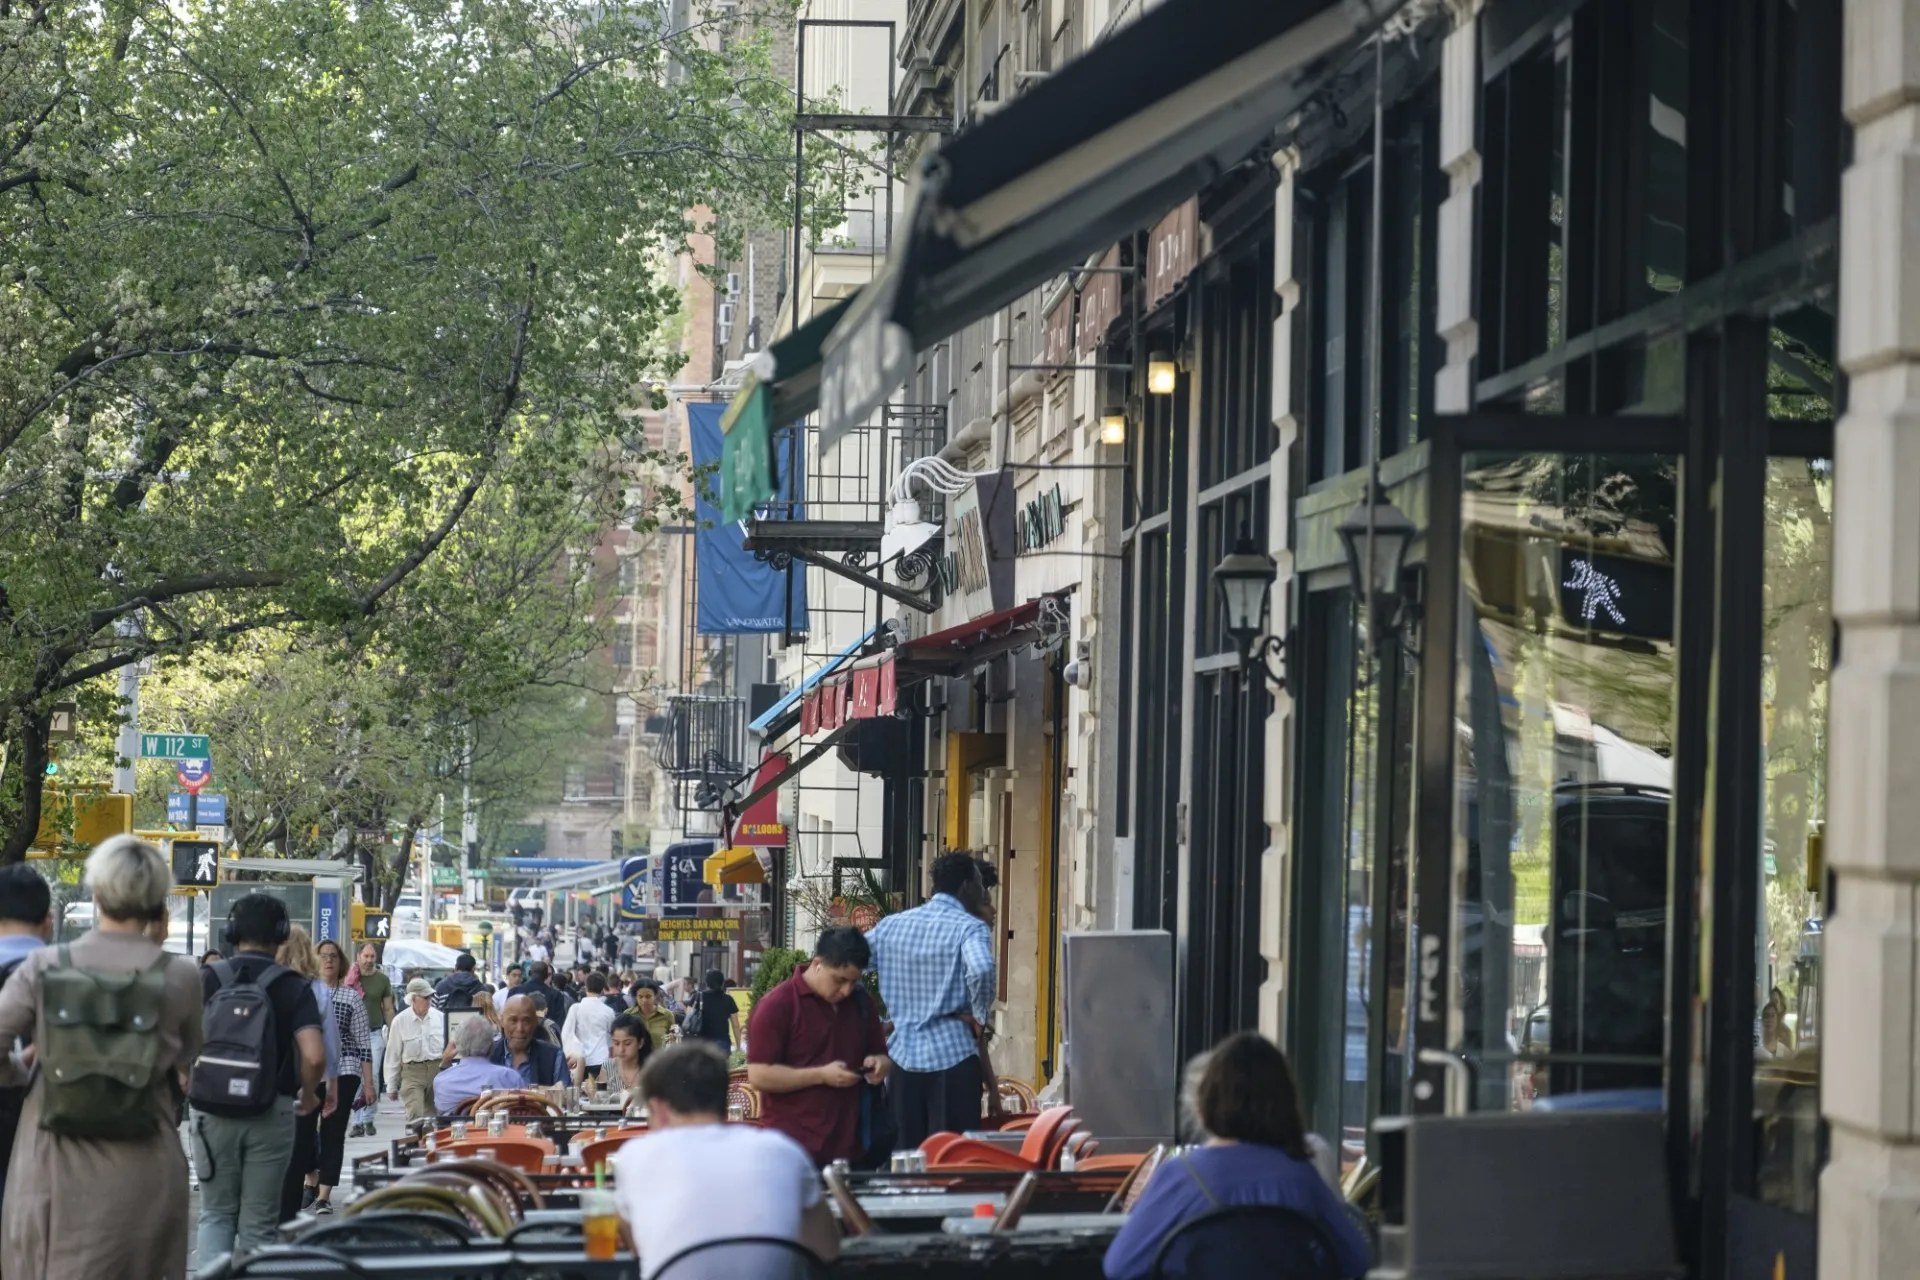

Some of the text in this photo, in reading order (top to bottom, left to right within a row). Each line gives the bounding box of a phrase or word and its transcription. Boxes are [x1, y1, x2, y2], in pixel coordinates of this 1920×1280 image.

[146, 737, 202, 756] W 112 ST
[168, 796, 181, 808] M4
[168, 810, 188, 821] M104
[659, 919, 691, 929] HEIGHTS
[693, 919, 708, 929] BAR
[709, 919, 724, 929] AND
[658, 930, 674, 940] DINE
[677, 930, 702, 940] ABOVE
[1420, 934, 1440, 1021] PULL
